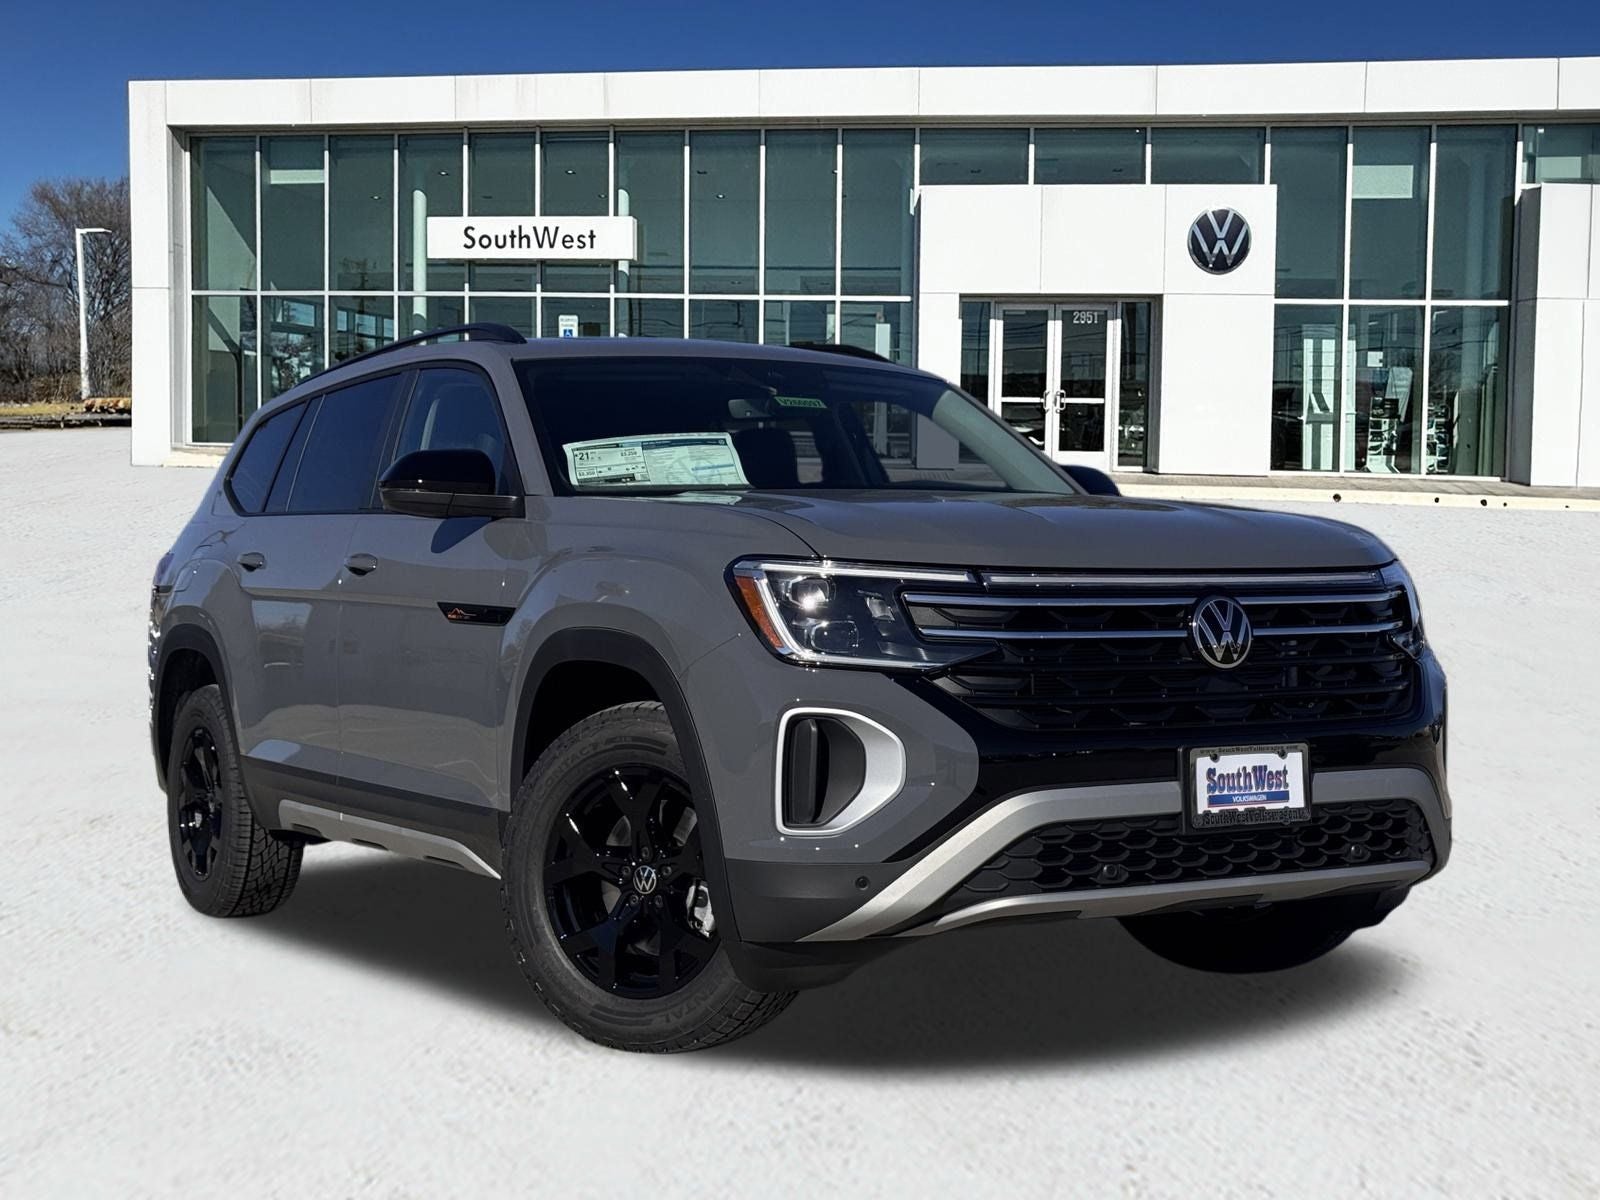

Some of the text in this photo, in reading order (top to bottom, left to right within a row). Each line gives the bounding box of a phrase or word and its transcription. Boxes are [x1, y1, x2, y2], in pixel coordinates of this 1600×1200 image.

[463, 225, 597, 250] SouthWest
[1073, 311, 1098, 324] 2951
[1206, 764, 1289, 794] SouthWest
[1232, 794, 1267, 803] VOLKSWAGEN
